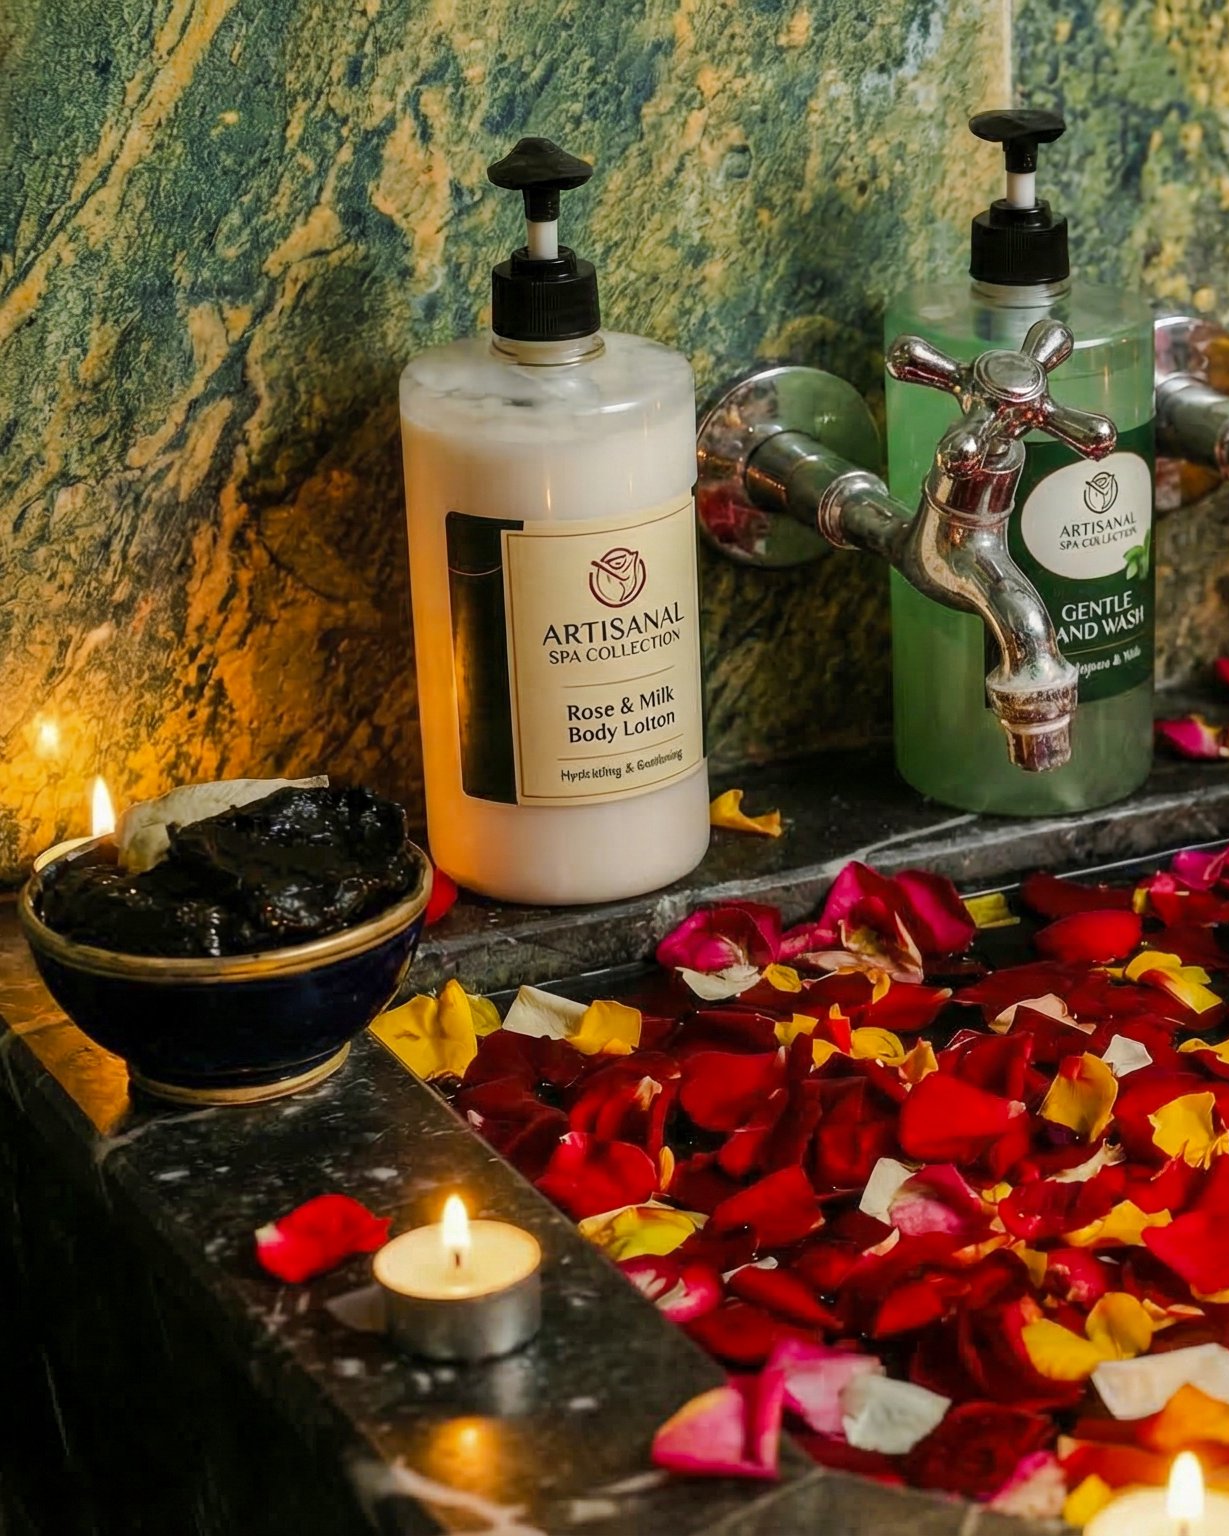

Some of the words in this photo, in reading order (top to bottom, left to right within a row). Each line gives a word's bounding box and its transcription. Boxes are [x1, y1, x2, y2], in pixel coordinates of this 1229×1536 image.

[1059, 511, 1137, 538] ARTISANAL
[1059, 540, 1079, 551] SPA
[1061, 590, 1133, 622] GENTLE
[543, 601, 685, 647] ARTISANAL
[1056, 621, 1099, 644] AND
[1101, 604, 1144, 636] WASH
[549, 649, 582, 665] SPA
[586, 628, 681, 662] COLLECTION
[567, 704, 615, 722] Rose
[620, 696, 634, 715] &
[639, 685, 675, 711] Milk
[568, 722, 618, 744] Body
